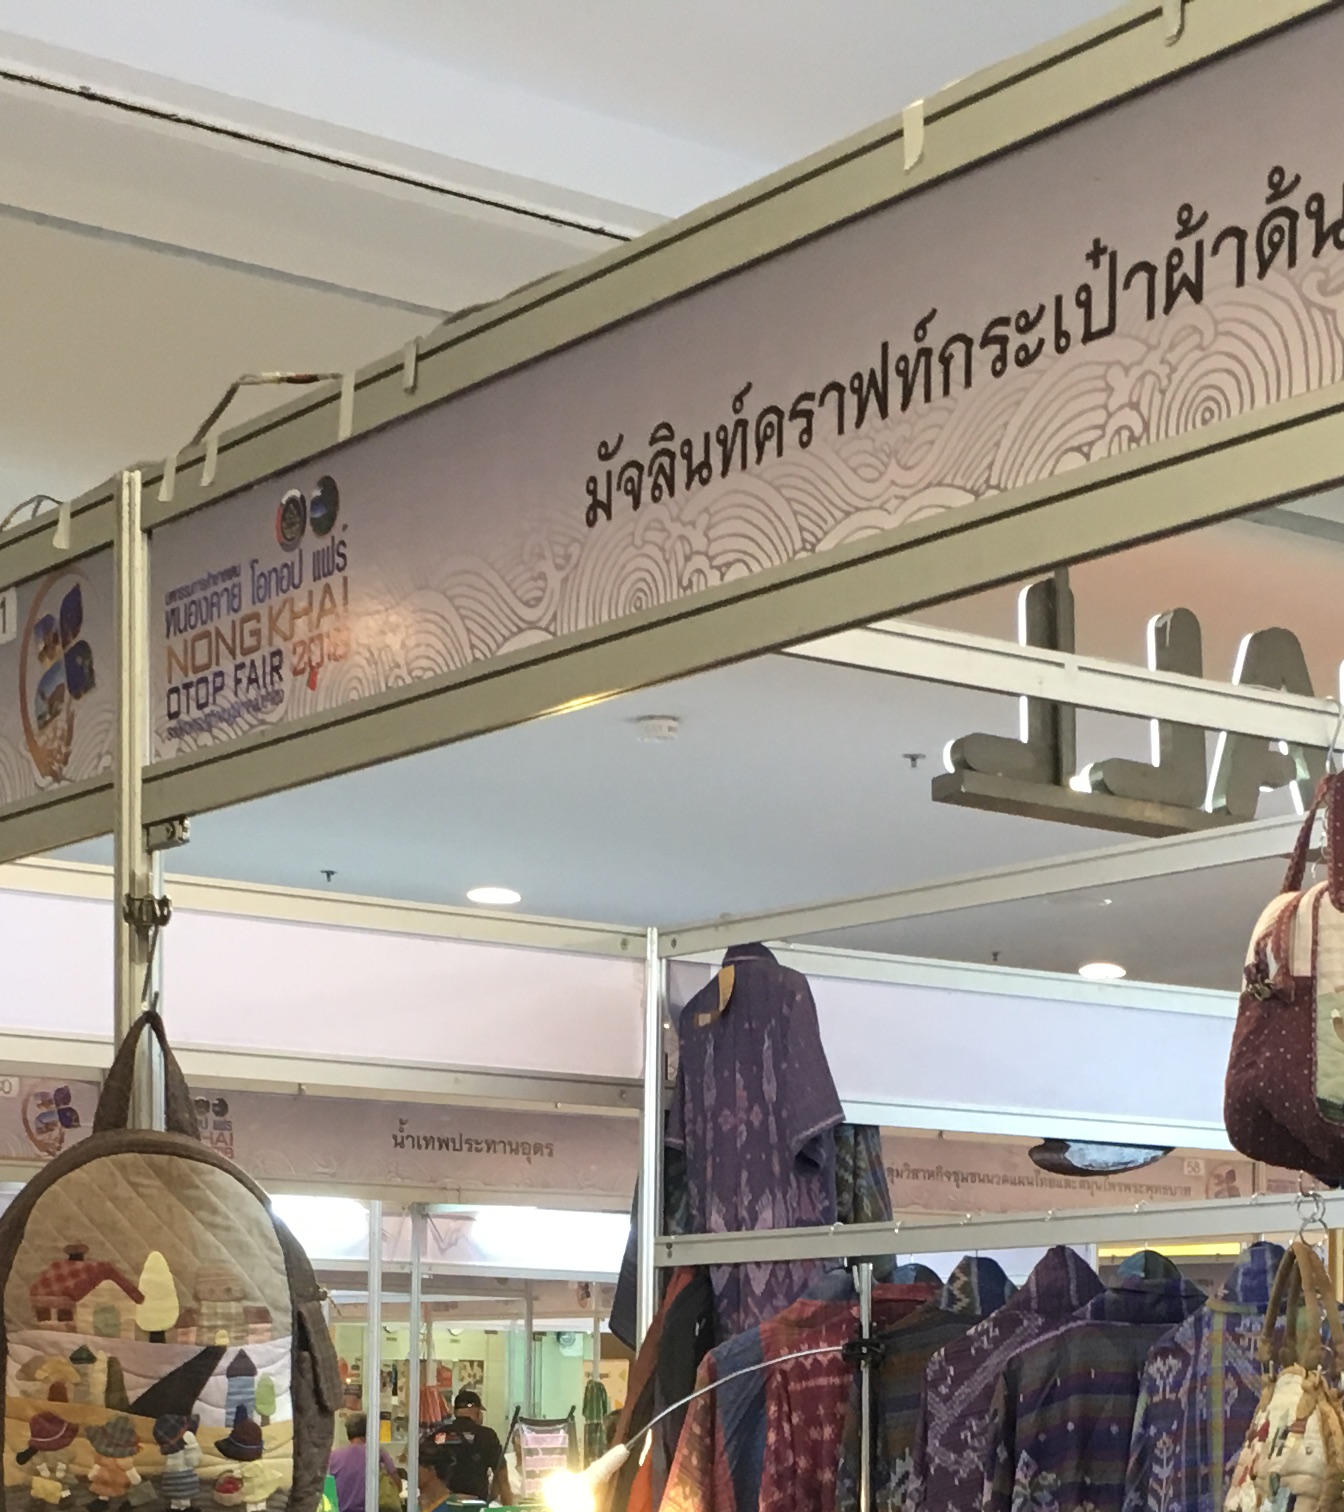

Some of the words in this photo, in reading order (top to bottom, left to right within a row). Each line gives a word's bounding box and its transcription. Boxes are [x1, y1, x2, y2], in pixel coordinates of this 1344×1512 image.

[166, 581, 242, 638] หนองคาย
[250, 549, 303, 605] โอทอป
[312, 524, 348, 582] แฟร์
[167, 612, 261, 683] NONG
[268, 576, 348, 645] KHAI
[167, 669, 224, 720] OTOP
[234, 649, 283, 697] FAIR
[200, 1132, 234, 1147] HAI
[392, 1118, 555, 1165] น้ำเทพประทานอุดร
[1187, 1162, 1201, 1175] 58
